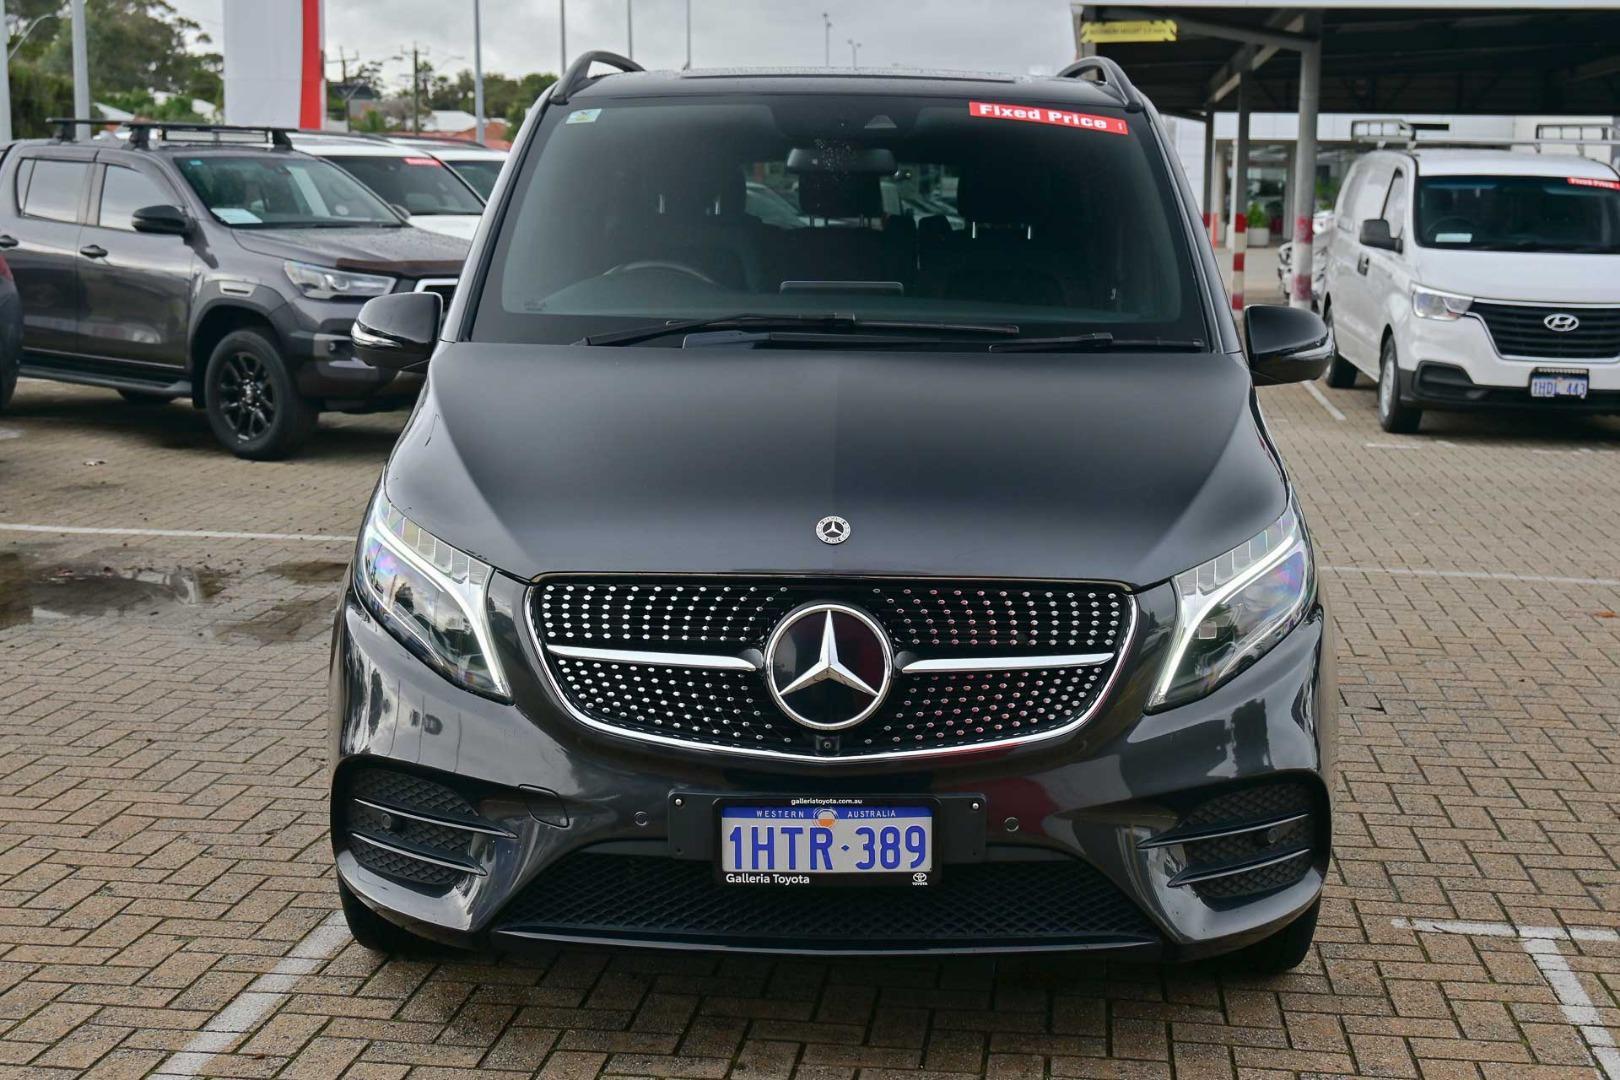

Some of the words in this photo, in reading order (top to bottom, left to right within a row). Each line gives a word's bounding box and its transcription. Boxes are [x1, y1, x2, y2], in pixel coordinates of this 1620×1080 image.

[1048, 110, 1107, 129] Price
[790, 798, 862, 806] galleriatoyota.com.au
[756, 810, 805, 818] WESTERN
[847, 810, 896, 818] AUSTRALIA
[726, 873, 770, 884] Galleria
[772, 874, 810, 885] Toyota
